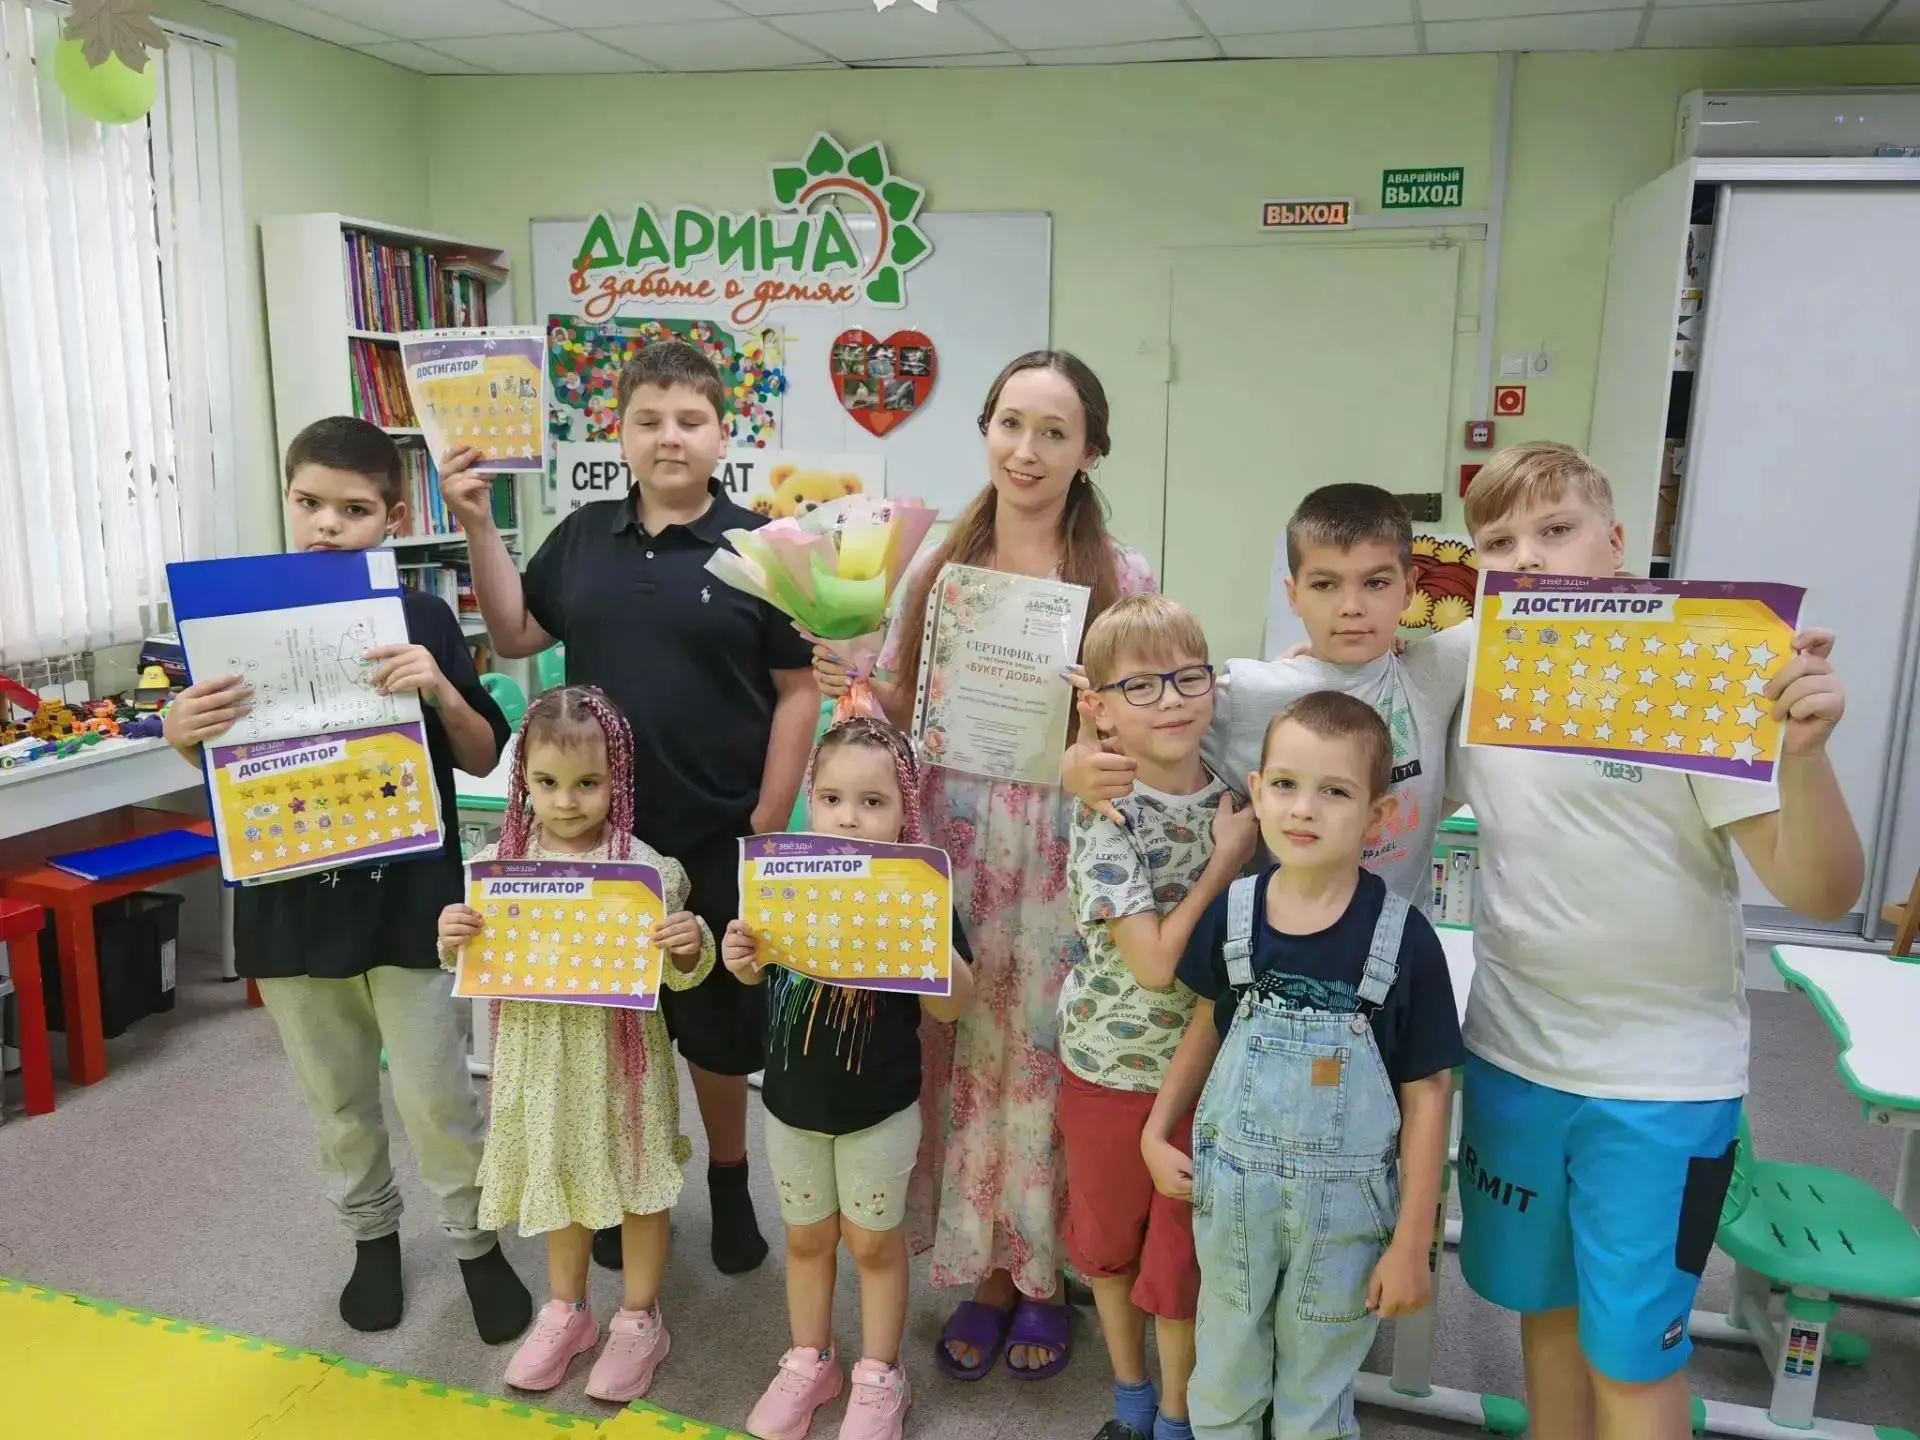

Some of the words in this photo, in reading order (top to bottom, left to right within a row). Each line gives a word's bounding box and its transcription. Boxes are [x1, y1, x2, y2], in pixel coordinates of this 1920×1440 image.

[1387, 169, 1460, 184] АВАРИЙНЫЙ
[1385, 184, 1459, 206] ВЫХОД
[1266, 204, 1345, 224] ВЫХОД
[572, 206, 858, 273] ДАРИНА
[569, 253, 593, 294] в
[724, 280, 744, 300] о
[416, 360, 479, 379] ДОСТИГАТОР
[572, 461, 753, 493] СЕРТАТ
[1512, 597, 1663, 615] ДОСТИГАТОР
[966, 639, 1051, 665] СЕРТИФИКАТ
[238, 745, 339, 778] ДОСТИГАТОР
[1395, 763, 1415, 780] ITY
[1361, 840, 1397, 861] PPAREL
[763, 860, 863, 876] ДОСТИГАТОР
[490, 881, 585, 895] ДОСТИГАТОР
[1459, 1134, 1539, 1214] RMIT
